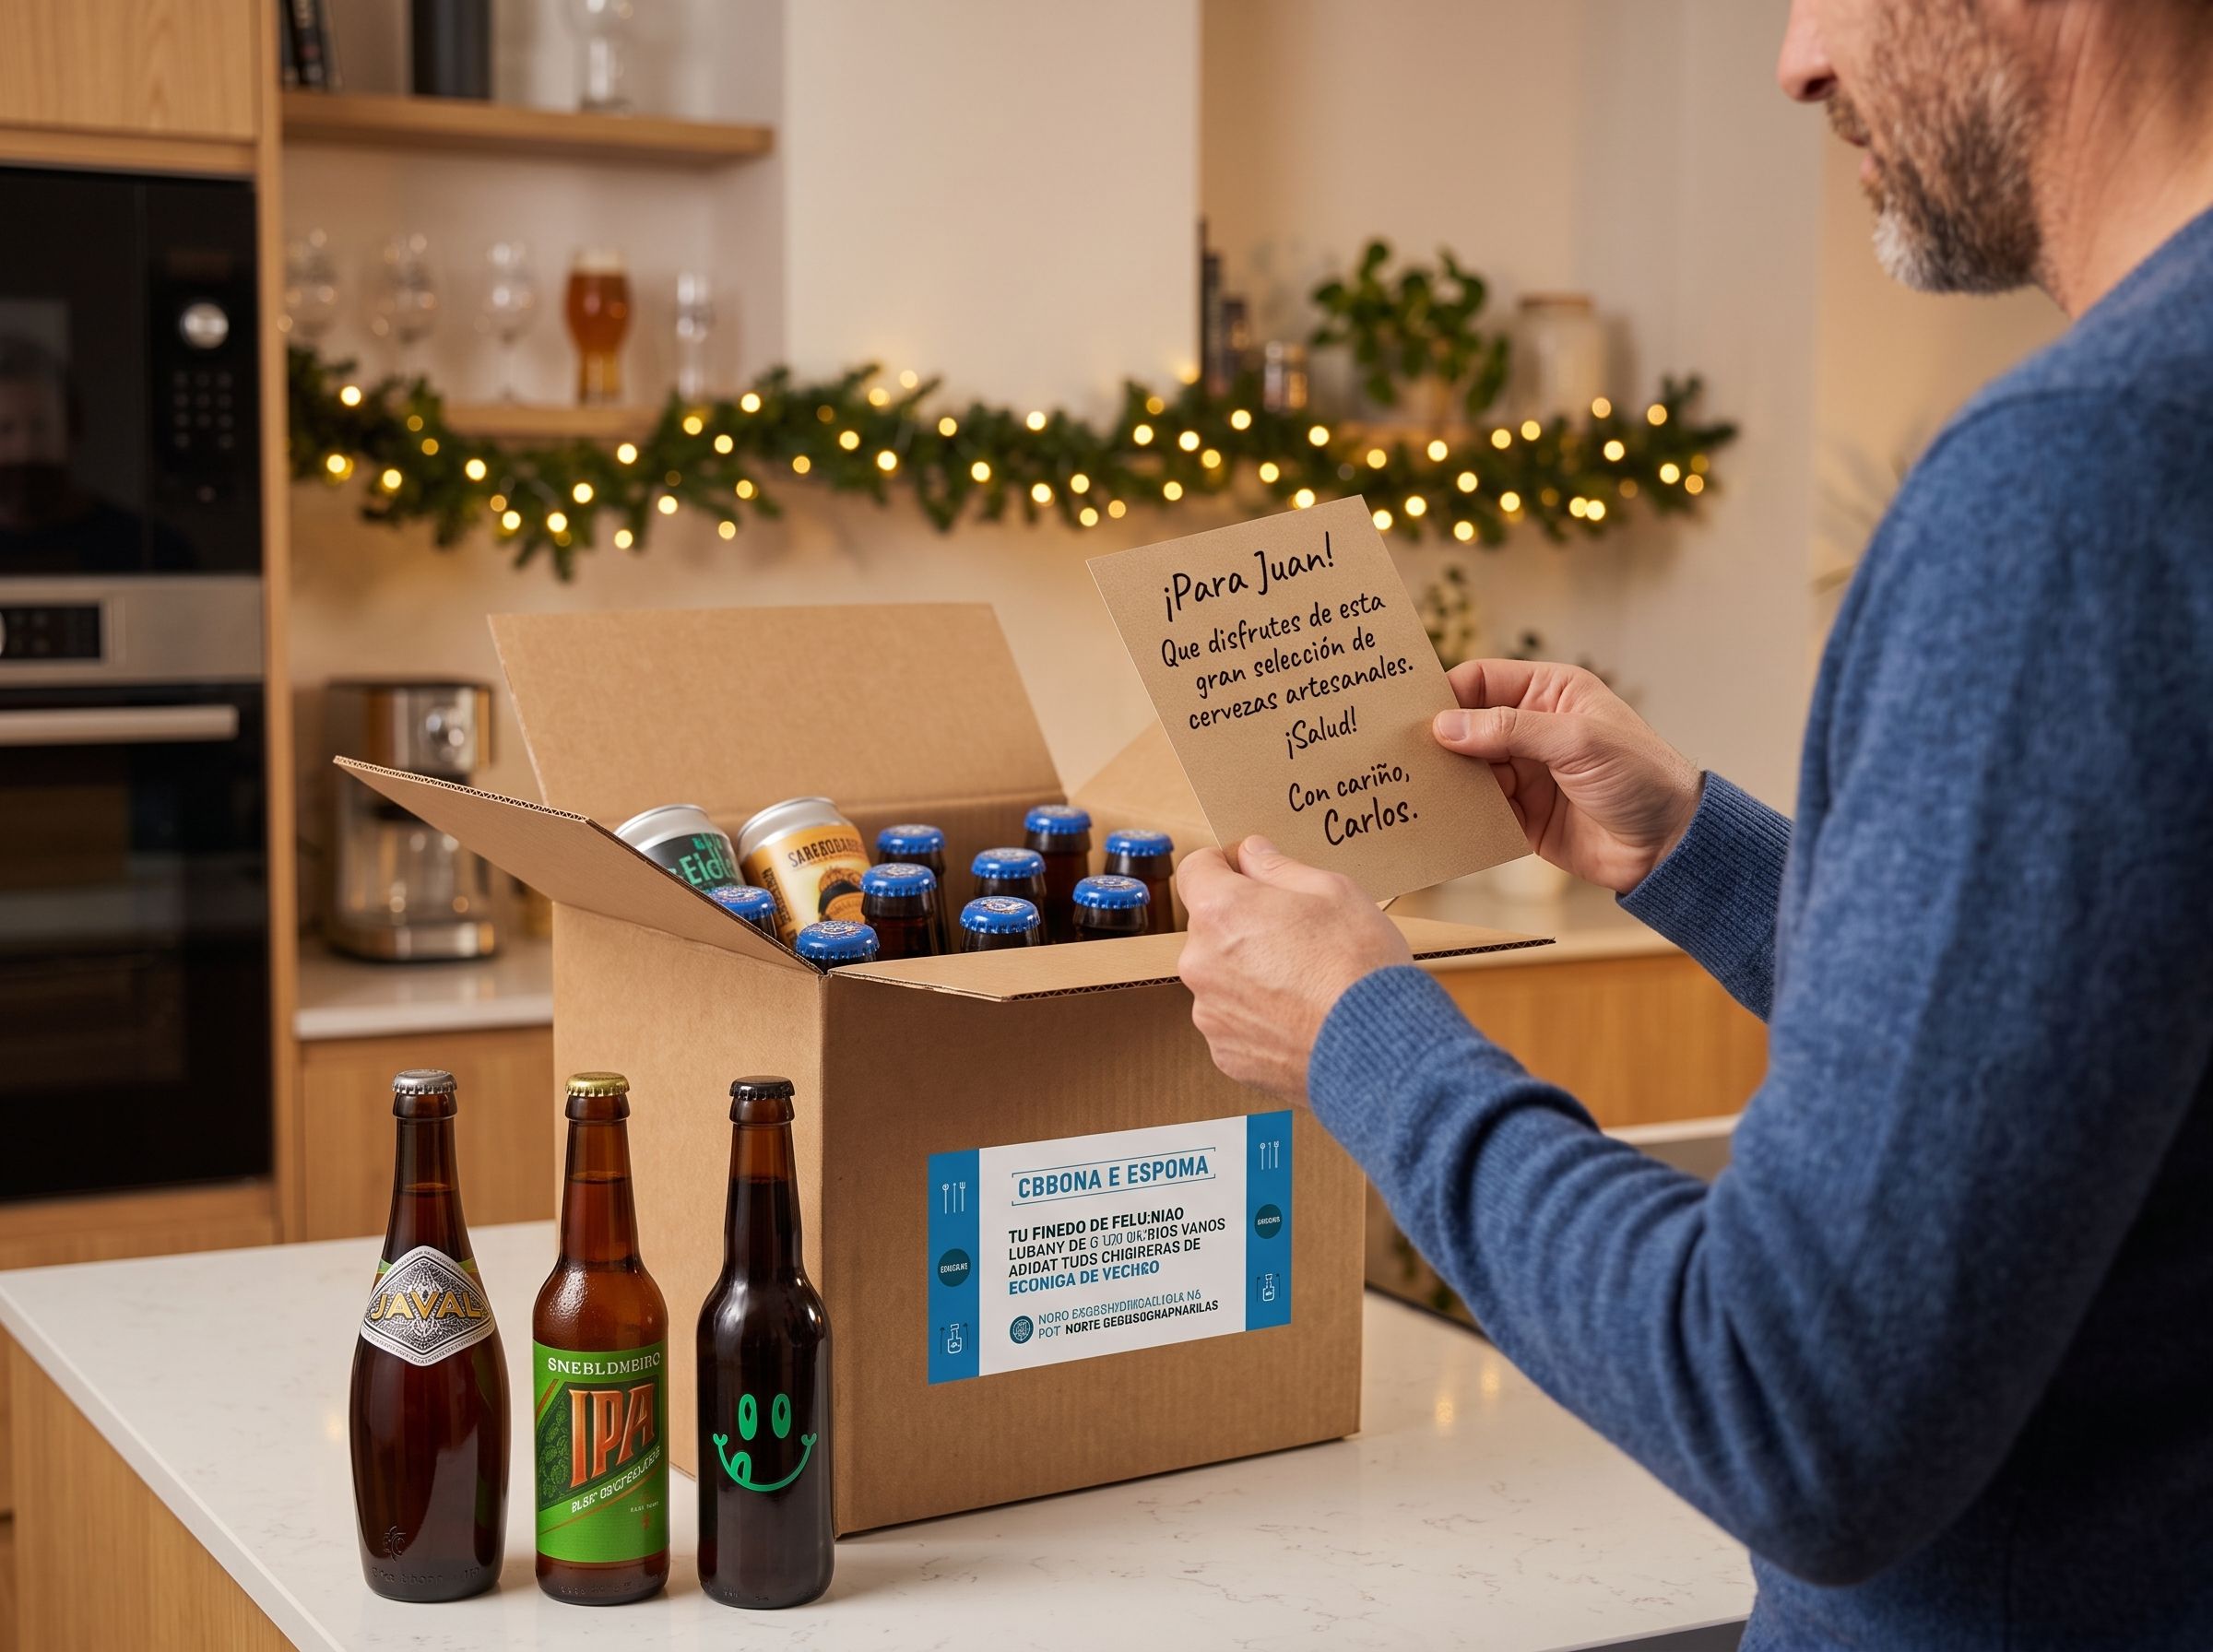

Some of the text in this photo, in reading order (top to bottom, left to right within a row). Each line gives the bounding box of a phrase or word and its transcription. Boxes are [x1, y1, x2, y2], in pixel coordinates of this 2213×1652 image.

[1164, 530, 1335, 623] ¡Para Juan!
[1161, 593, 1387, 667] Que disfrutes de esta
[1196, 625, 1376, 700] gran selección de
[1189, 655, 1414, 730] cervezas artesanales.
[1284, 705, 1357, 761] ¡Salud!
[1288, 762, 1411, 813] Con cariño,
[1324, 796, 1418, 846] Carlos.
[1018, 1155, 1209, 1198] CBBONA E ESPOMA
[1009, 1229, 1028, 1244] TU
[1032, 1220, 1086, 1240] FINEDO
[1090, 1217, 1108, 1232] DE
[1009, 1241, 1065, 1260] LUBANY
[1069, 1237, 1086, 1253] DE
[1181, 1218, 1225, 1235] VANOS
[1009, 1237, 1201, 1278] ADIDAT TUDS CHIGIRERAS DE
[1009, 1274, 1076, 1295] ECONIGA
[1080, 1268, 1099, 1284] DE
[370, 1292, 483, 1320] JAVAL
[1038, 1310, 1069, 1326] NORO
[1038, 1326, 1060, 1339] POT
[1065, 1318, 1101, 1335] NORTE
[568, 1383, 655, 1489] IPA
